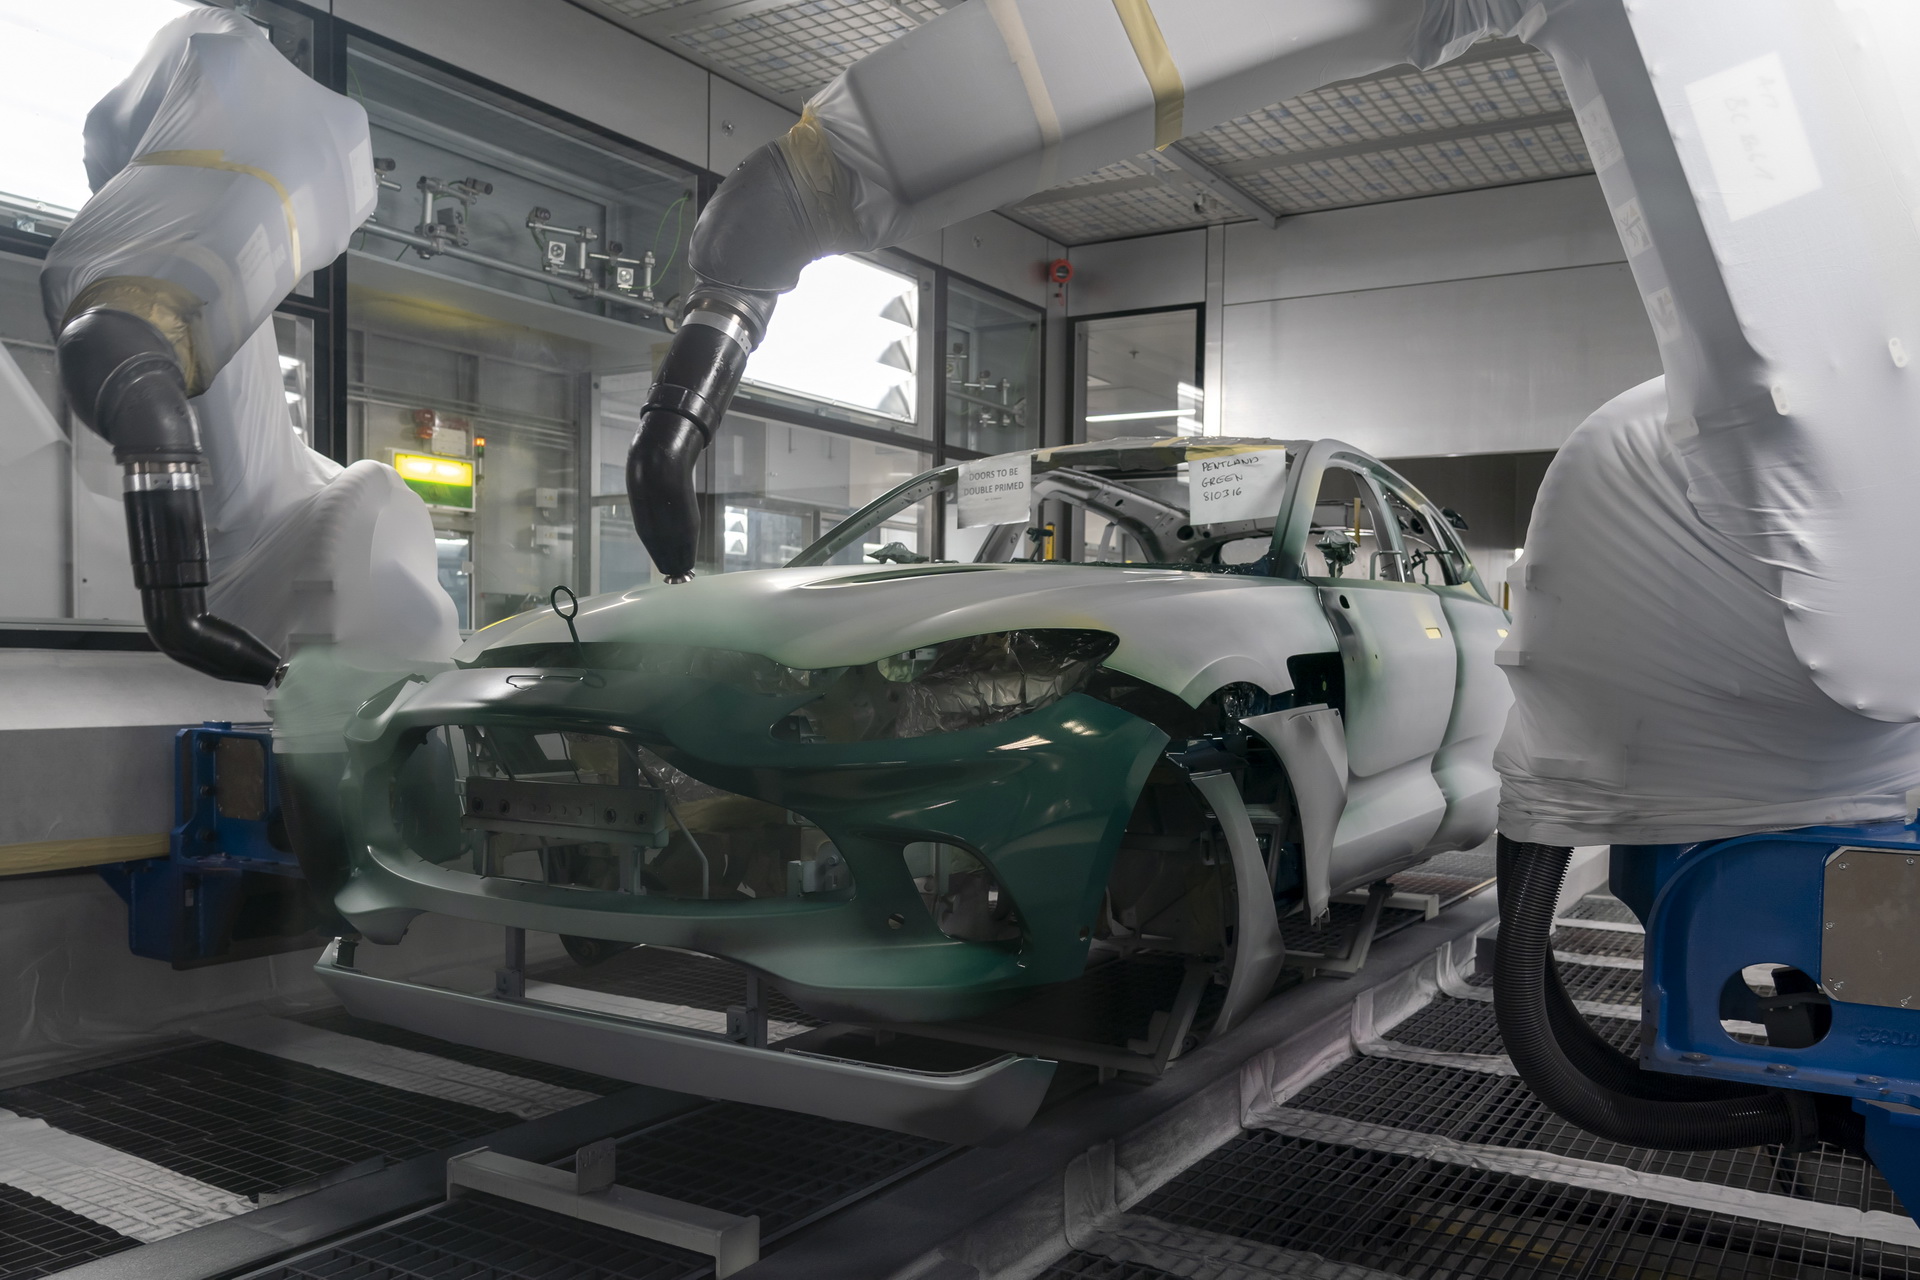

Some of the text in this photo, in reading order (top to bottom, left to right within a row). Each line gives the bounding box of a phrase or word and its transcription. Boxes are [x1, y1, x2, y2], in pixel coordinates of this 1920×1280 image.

[1202, 456, 1259, 472] PENTLAND
[969, 467, 1018, 481] DOORS TO BE
[1201, 473, 1243, 488] GREEN
[963, 481, 1024, 496] DOUBLE PRIMED
